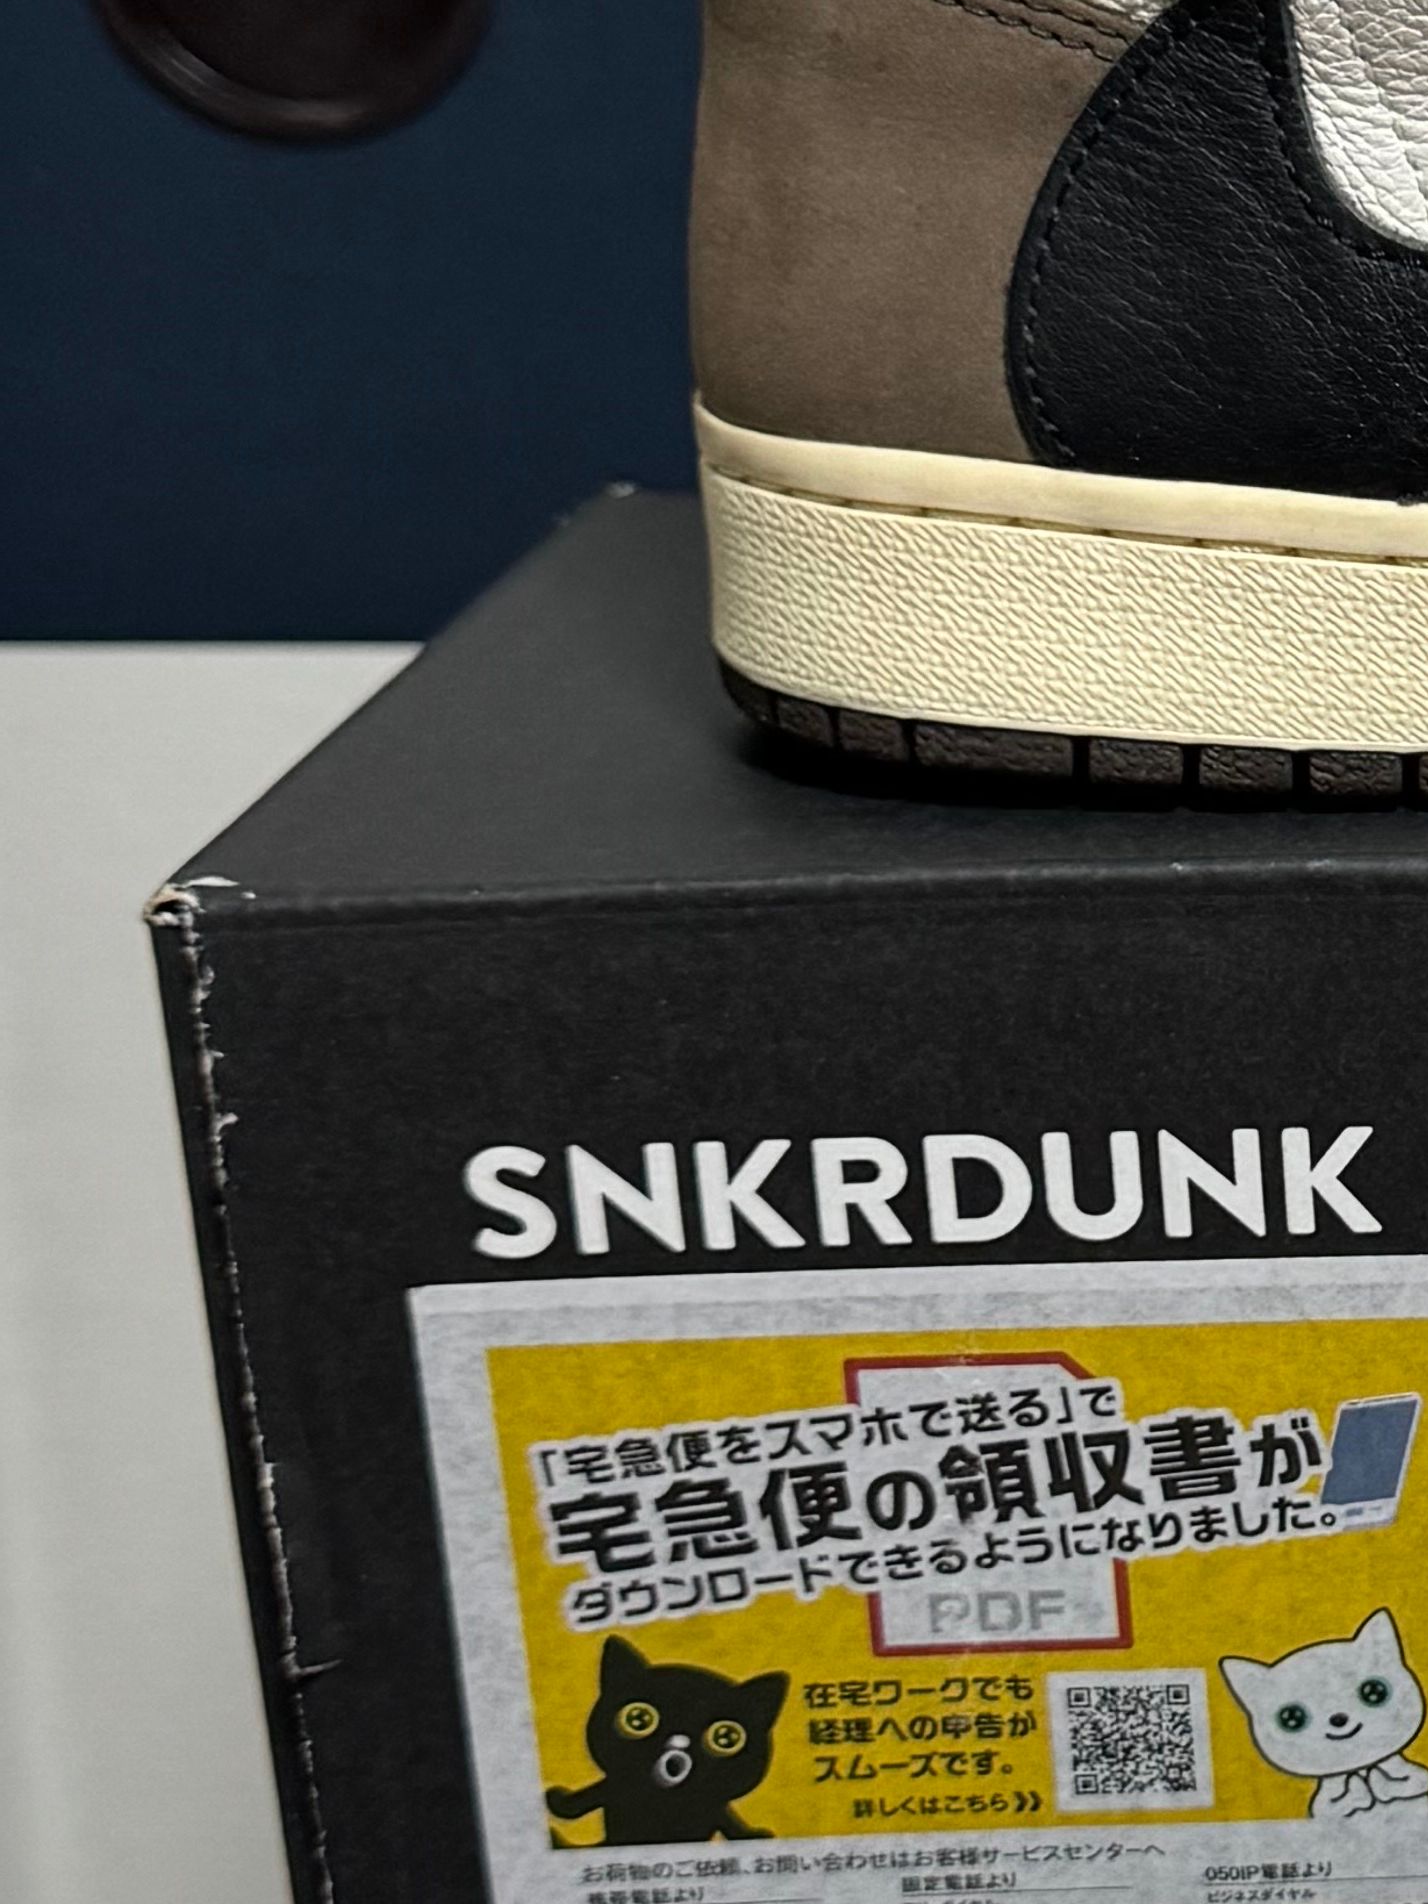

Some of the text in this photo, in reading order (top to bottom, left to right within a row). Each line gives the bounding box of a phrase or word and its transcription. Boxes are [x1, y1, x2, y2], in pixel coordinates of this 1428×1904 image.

[466, 1124, 1386, 1259] SNKRDUNK
[538, 1385, 1117, 1488] 「宅急便をスマホで送る」で
[549, 1415, 1322, 1573] 宅急便の領収書が
[572, 1497, 1336, 1624] ダウンロードできるようになりました。
[928, 1590, 1066, 1633] PDF
[804, 1675, 1034, 1709] 在宅ワークでも
[808, 1710, 1038, 1745] 経理への申告が
[814, 1749, 1013, 1783] スムーズです。
[1205, 1861, 1332, 1881] 050IP電話より
